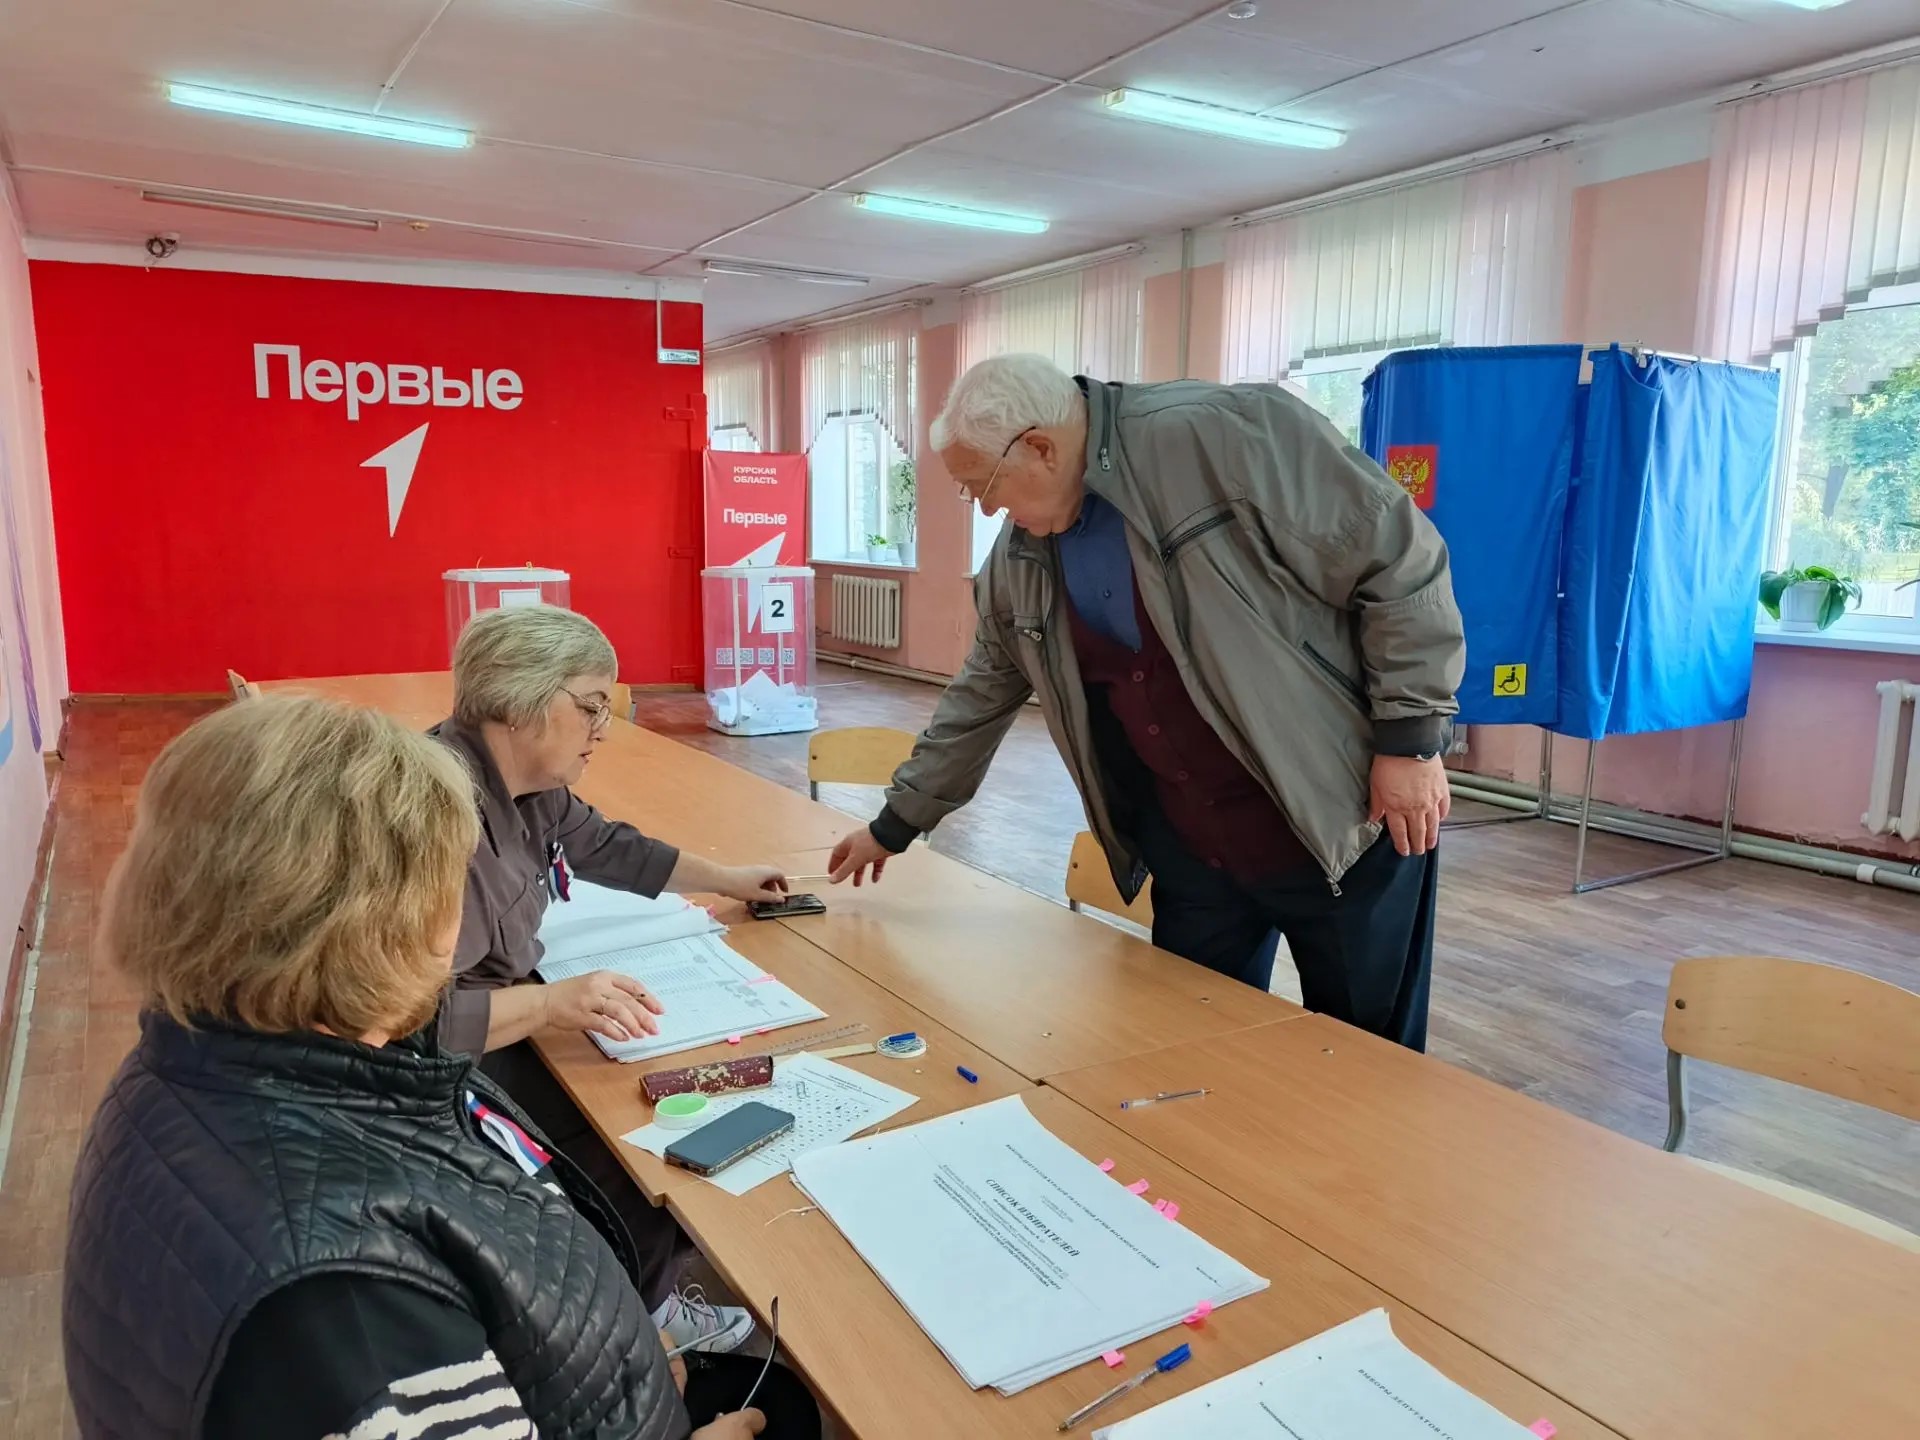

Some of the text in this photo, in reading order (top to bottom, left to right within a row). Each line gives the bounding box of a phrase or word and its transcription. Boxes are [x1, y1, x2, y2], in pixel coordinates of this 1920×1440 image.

[253, 342, 524, 421] Первые
[733, 466, 777, 475] КУРСКАЯ
[733, 475, 778, 485] ОБЛАСТЬ
[723, 508, 788, 529] Первые
[771, 599, 785, 618] 2
[985, 1178, 1019, 1208] СПИСОК
[1017, 1205, 1081, 1257] ИЗБИРАТЕЛЕЙ
